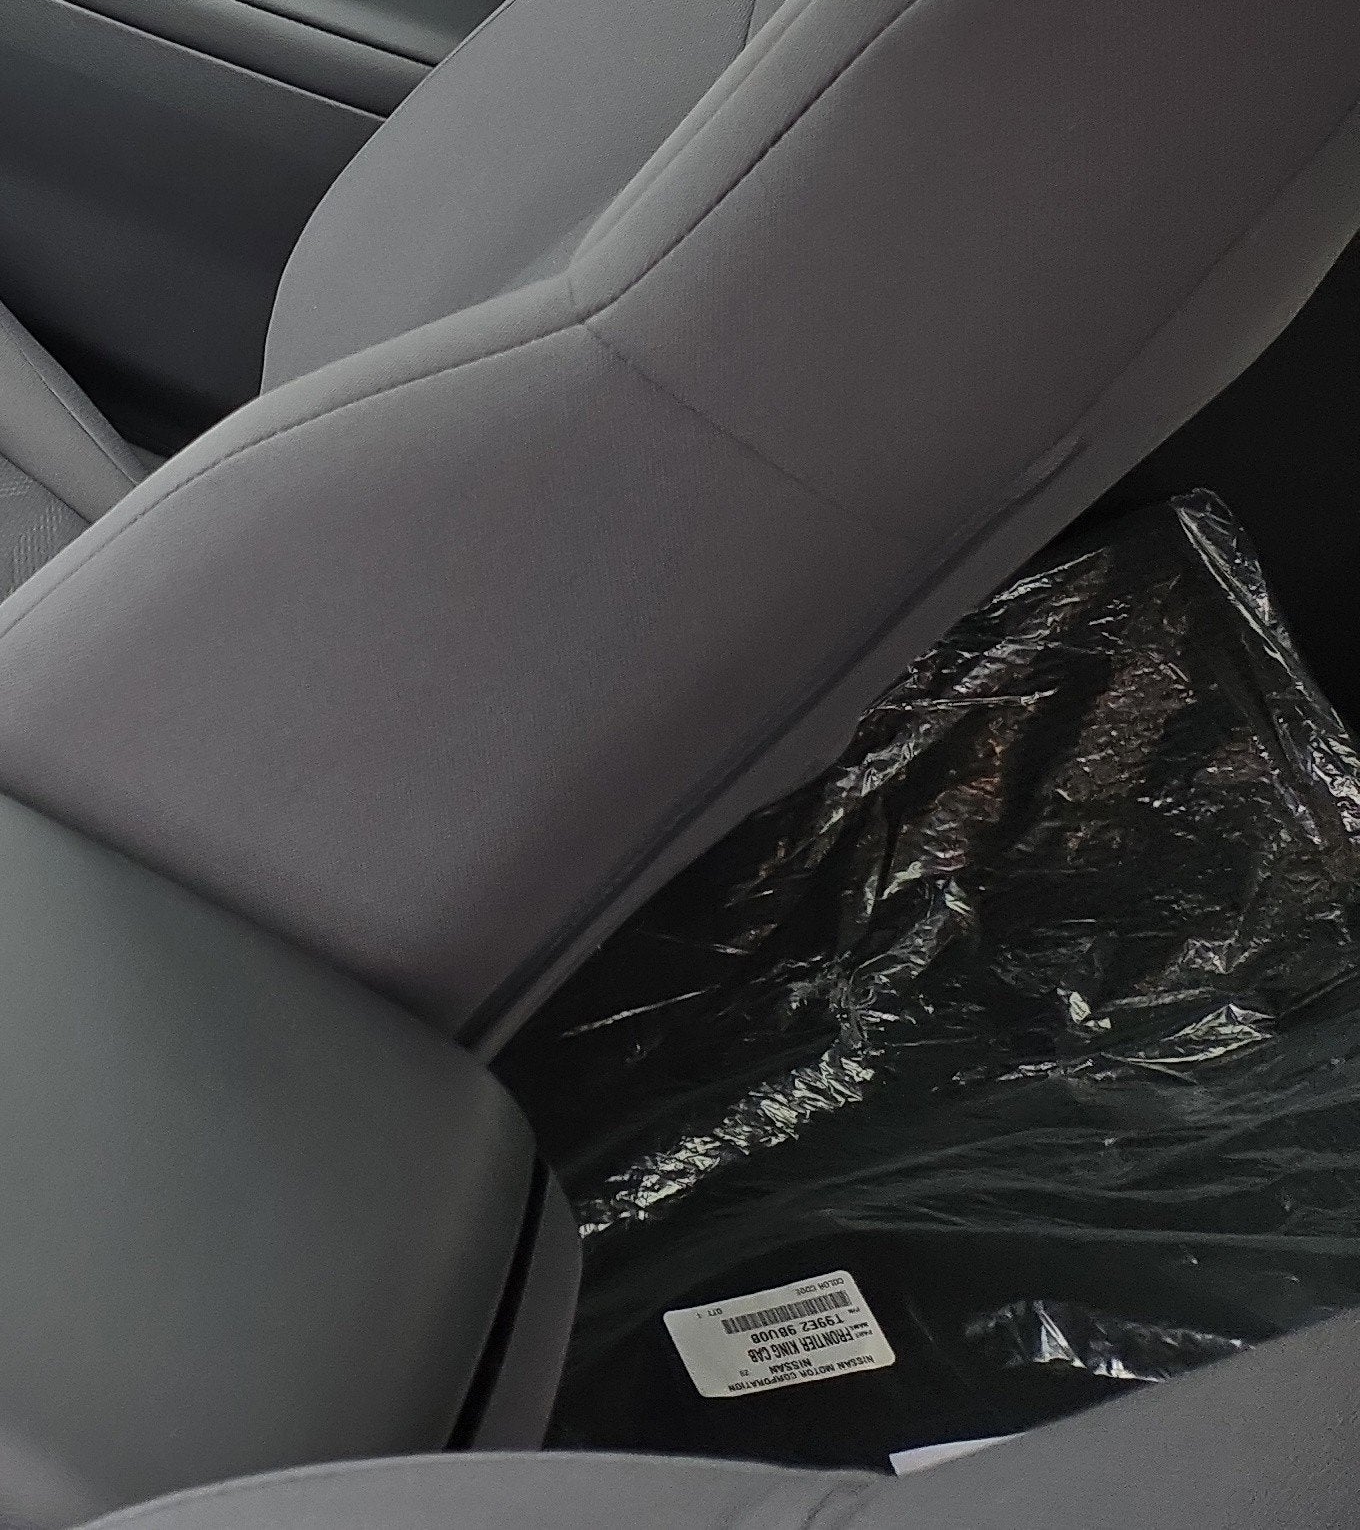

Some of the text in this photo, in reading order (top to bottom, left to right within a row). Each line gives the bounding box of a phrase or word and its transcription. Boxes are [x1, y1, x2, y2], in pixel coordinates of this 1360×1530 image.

[794, 1276, 845, 1296] COLOR CODE
[799, 1313, 844, 1332] T99E2
[747, 1327, 854, 1363] FRONTIER KING CAB
[727, 1354, 875, 1392] NISSAN MOTOR CORPORATION
[768, 1358, 812, 1374] NISSAN
